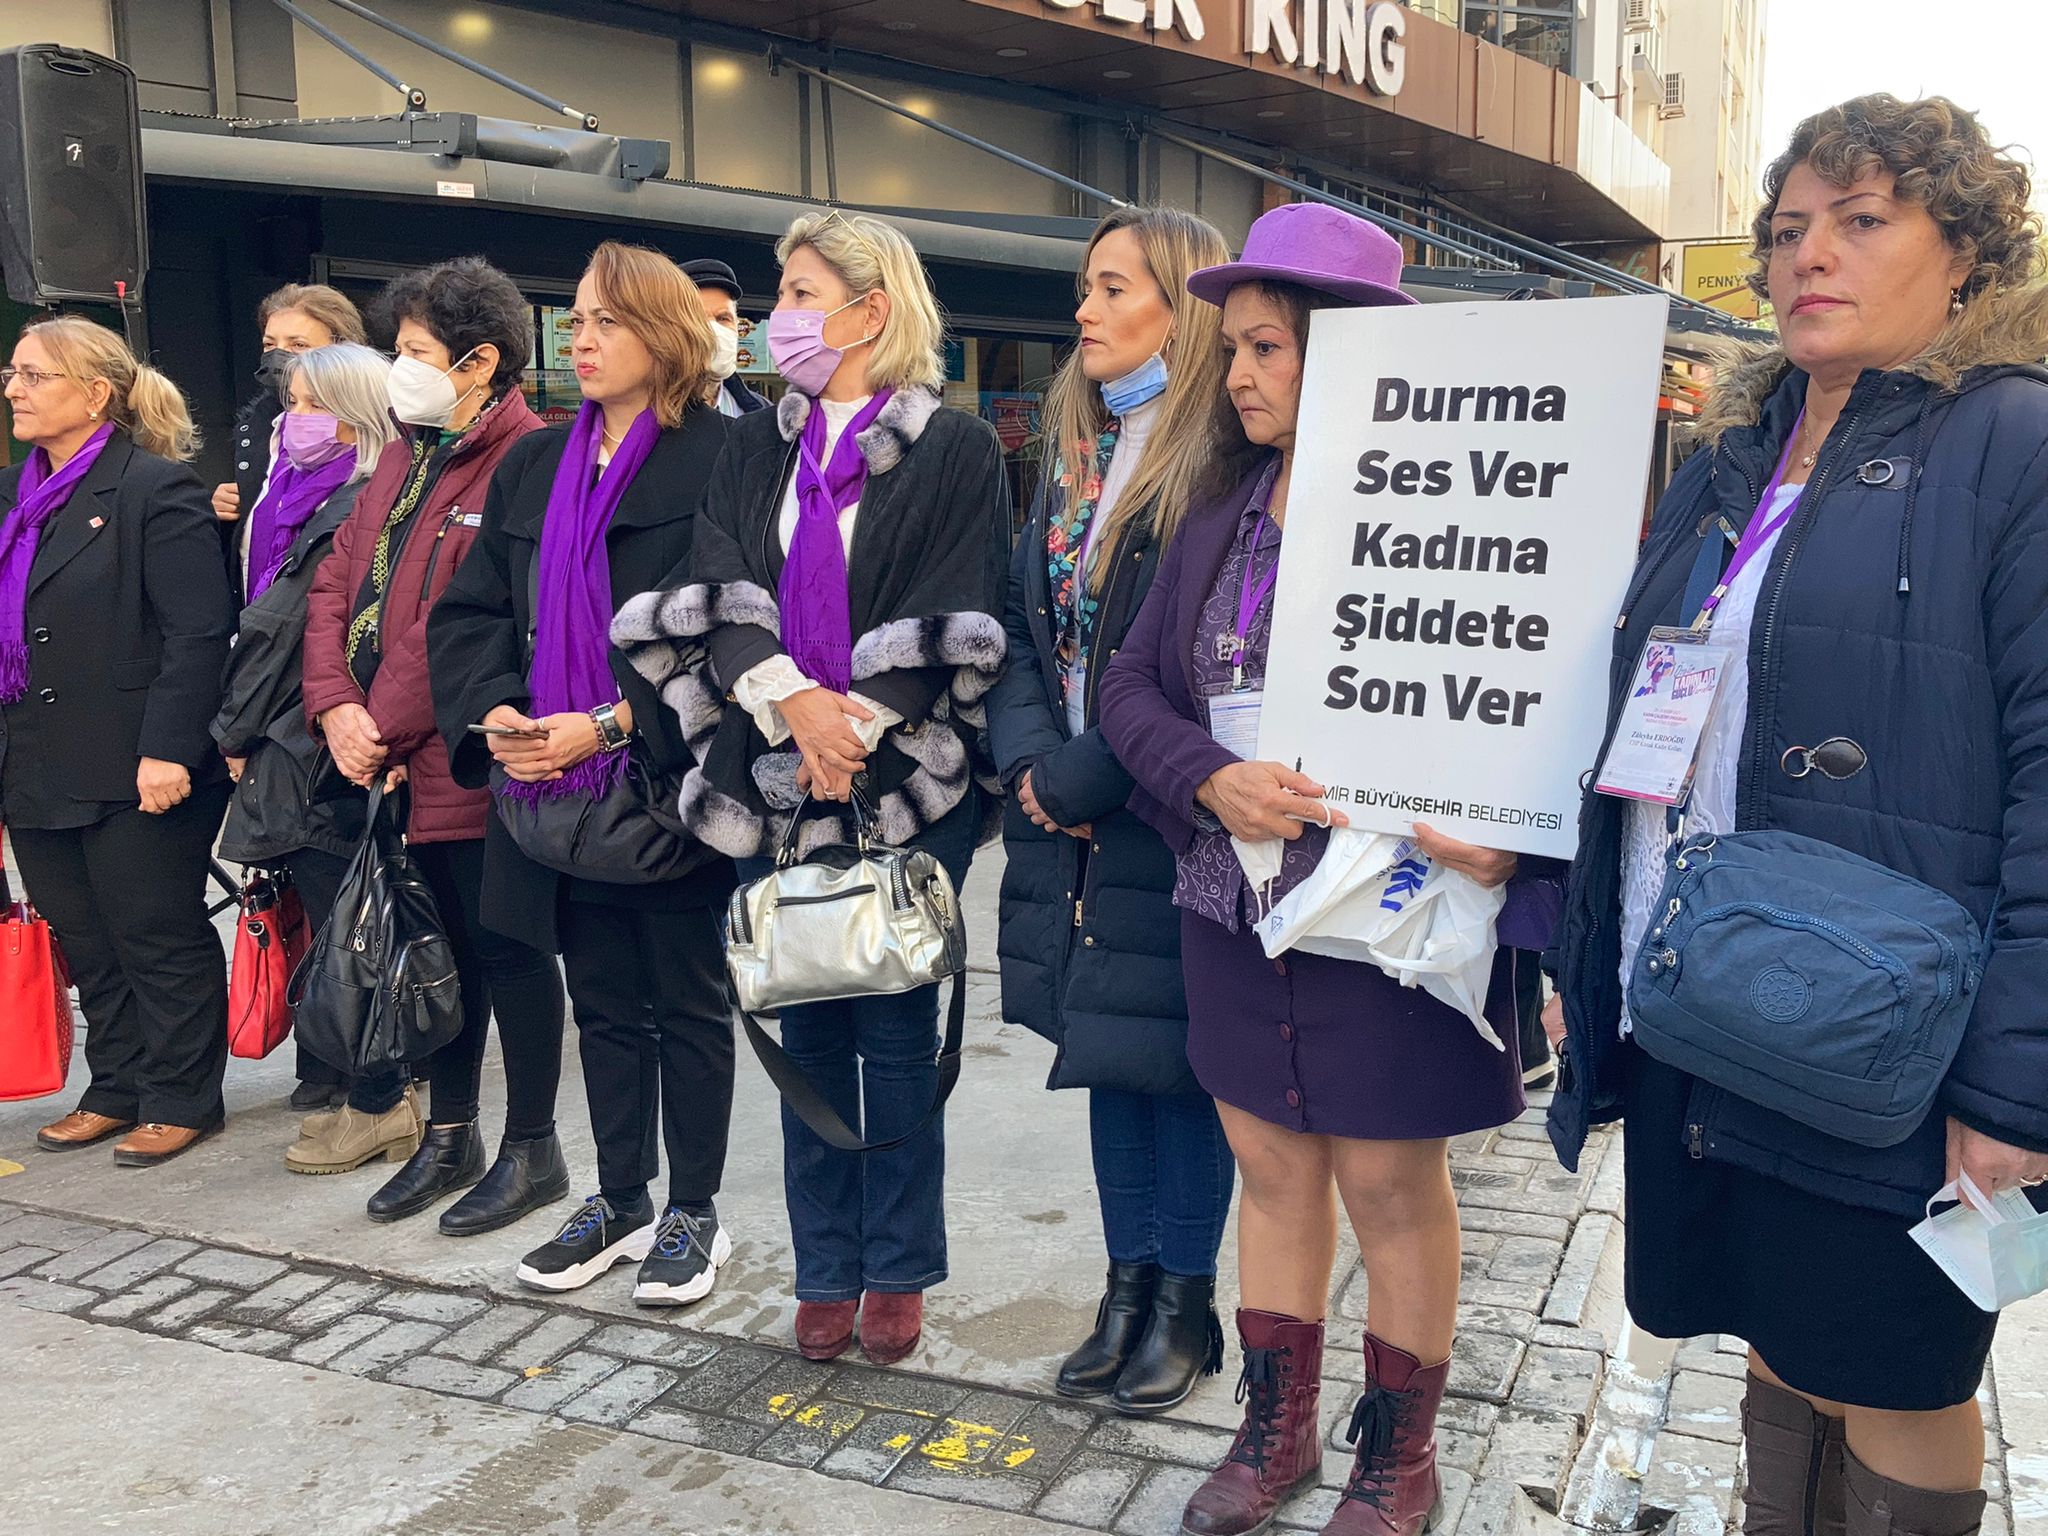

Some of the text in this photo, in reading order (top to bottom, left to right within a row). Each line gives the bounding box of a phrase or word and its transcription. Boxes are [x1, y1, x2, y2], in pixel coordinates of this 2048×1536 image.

[1246, 0, 1406, 96] KING
[1697, 275, 1743, 288] PENNY
[1372, 377, 1567, 423] Durma
[1353, 449, 1569, 498] Ses Ver
[1351, 522, 1549, 575] Kadına
[1332, 593, 1549, 652] Şiddete
[1323, 665, 1542, 727] Son Ver
[1315, 785, 1350, 803] MİR
[1354, 789, 1463, 817] BÜYÜKŞEHİR
